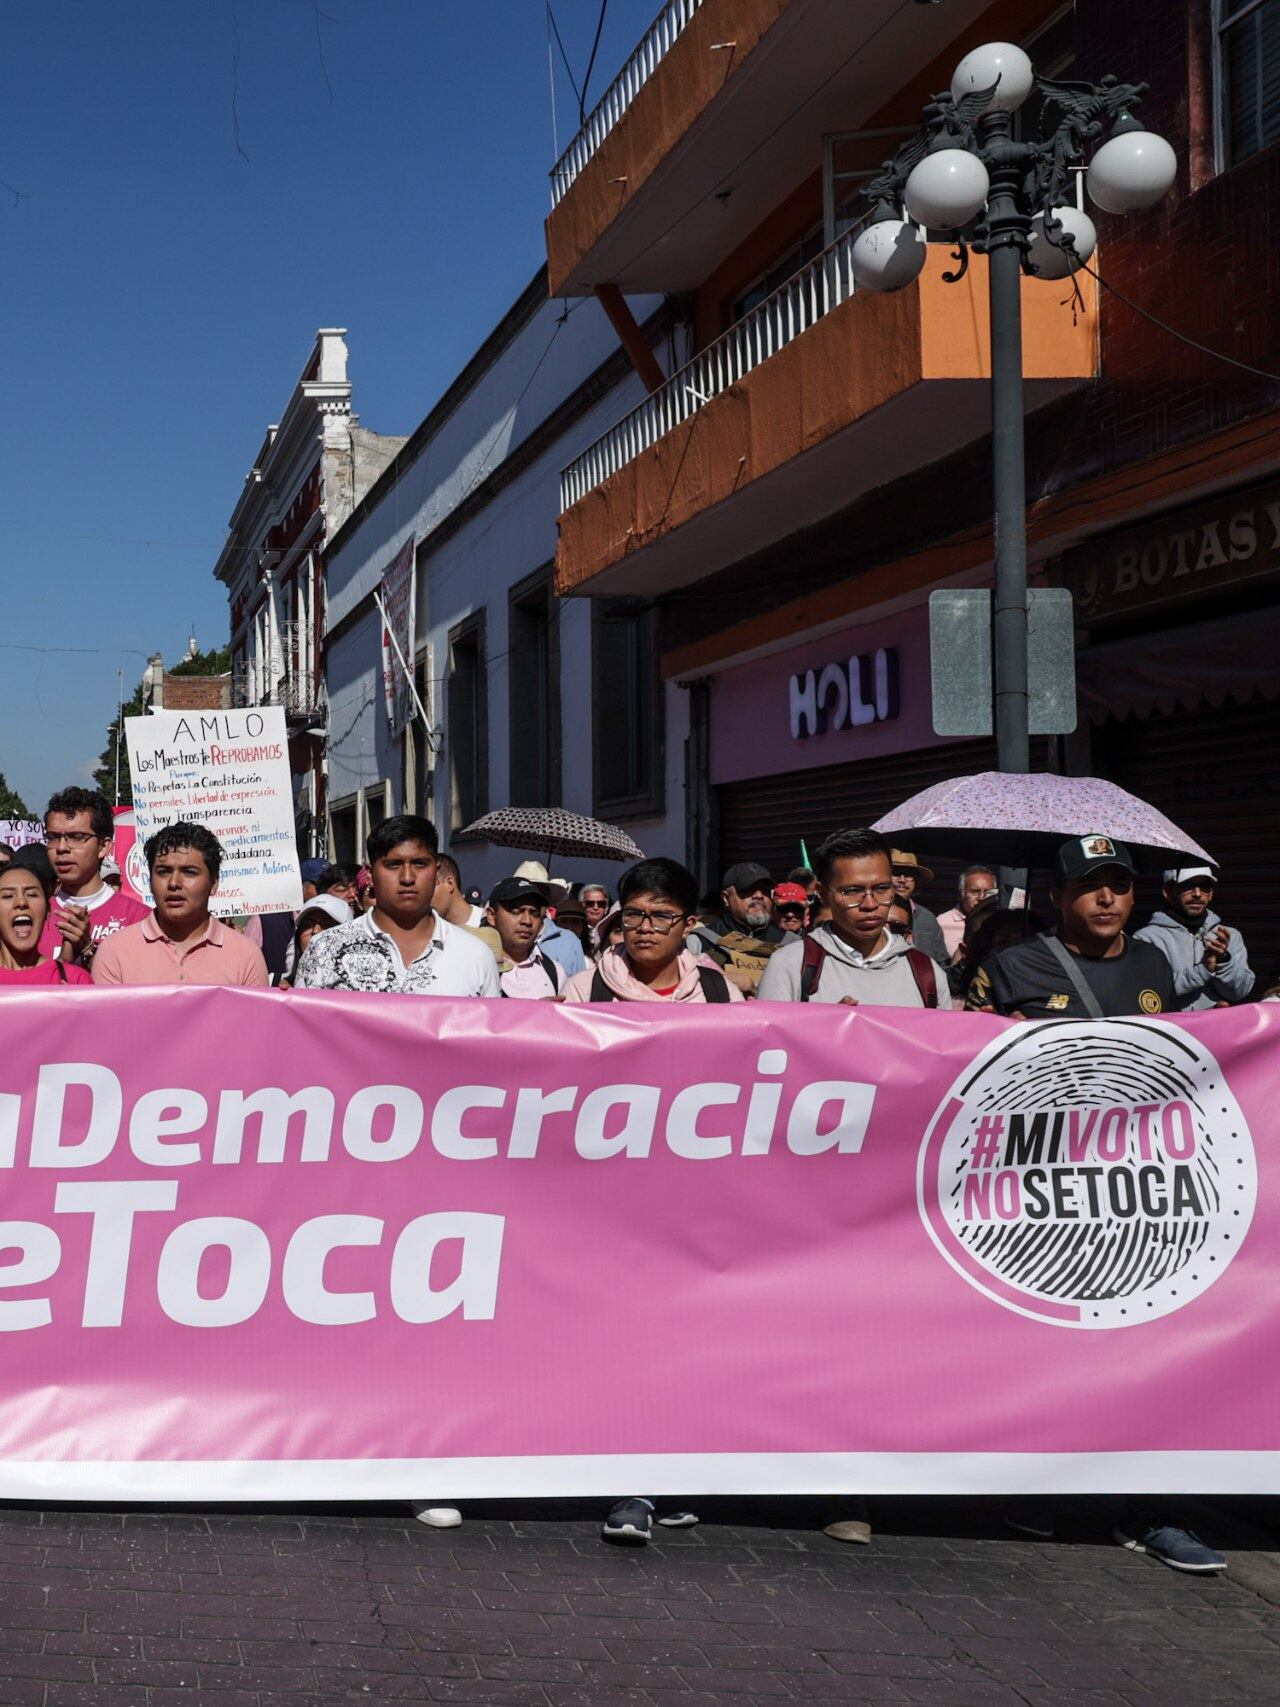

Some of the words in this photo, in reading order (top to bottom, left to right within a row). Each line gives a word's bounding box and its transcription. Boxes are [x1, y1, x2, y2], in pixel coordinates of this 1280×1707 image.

[1114, 509, 1258, 593] BOTAS
[789, 648, 900, 739] HOLI
[173, 713, 264, 743] AMLO
[133, 783, 147, 794] No
[134, 798, 147, 810] No
[8, 820, 23, 831] YO
[136, 815, 149, 826] No
[153, 813, 171, 826] hay
[971, 1100, 1197, 1169] #MIVOTO
[963, 1165, 1205, 1221] NOSETOCA
